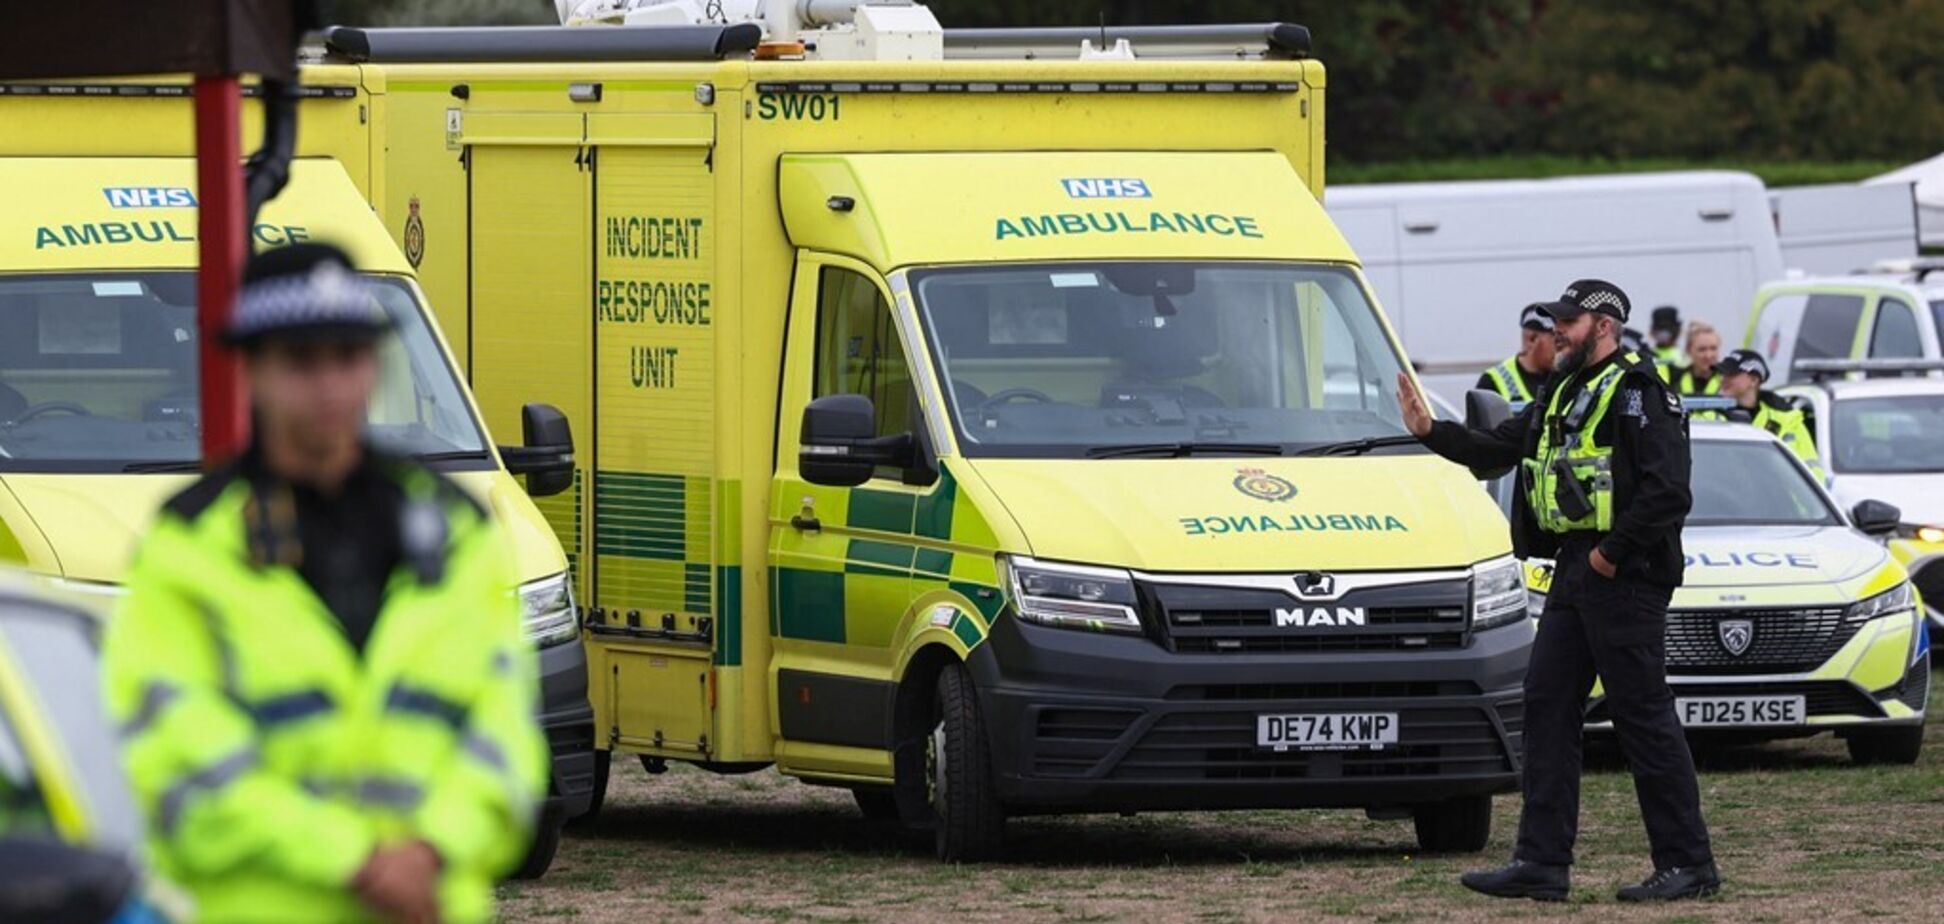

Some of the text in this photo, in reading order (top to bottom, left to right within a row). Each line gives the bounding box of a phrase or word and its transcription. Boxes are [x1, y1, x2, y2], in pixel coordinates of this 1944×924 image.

[758, 92, 839, 121] SW01
[110, 188, 193, 207] NHS
[1068, 179, 1145, 197] NHS
[35, 220, 310, 250] AMBULCE
[606, 216, 703, 260] INCIDENT
[996, 212, 1264, 240] AMBULANCE
[599, 280, 711, 326] RESPONSE
[631, 345, 678, 389] UNIT
[1275, 607, 1366, 627] MAN
[1685, 700, 1796, 723] FD25 KSE
[1267, 715, 1389, 742] DE74 KWP
